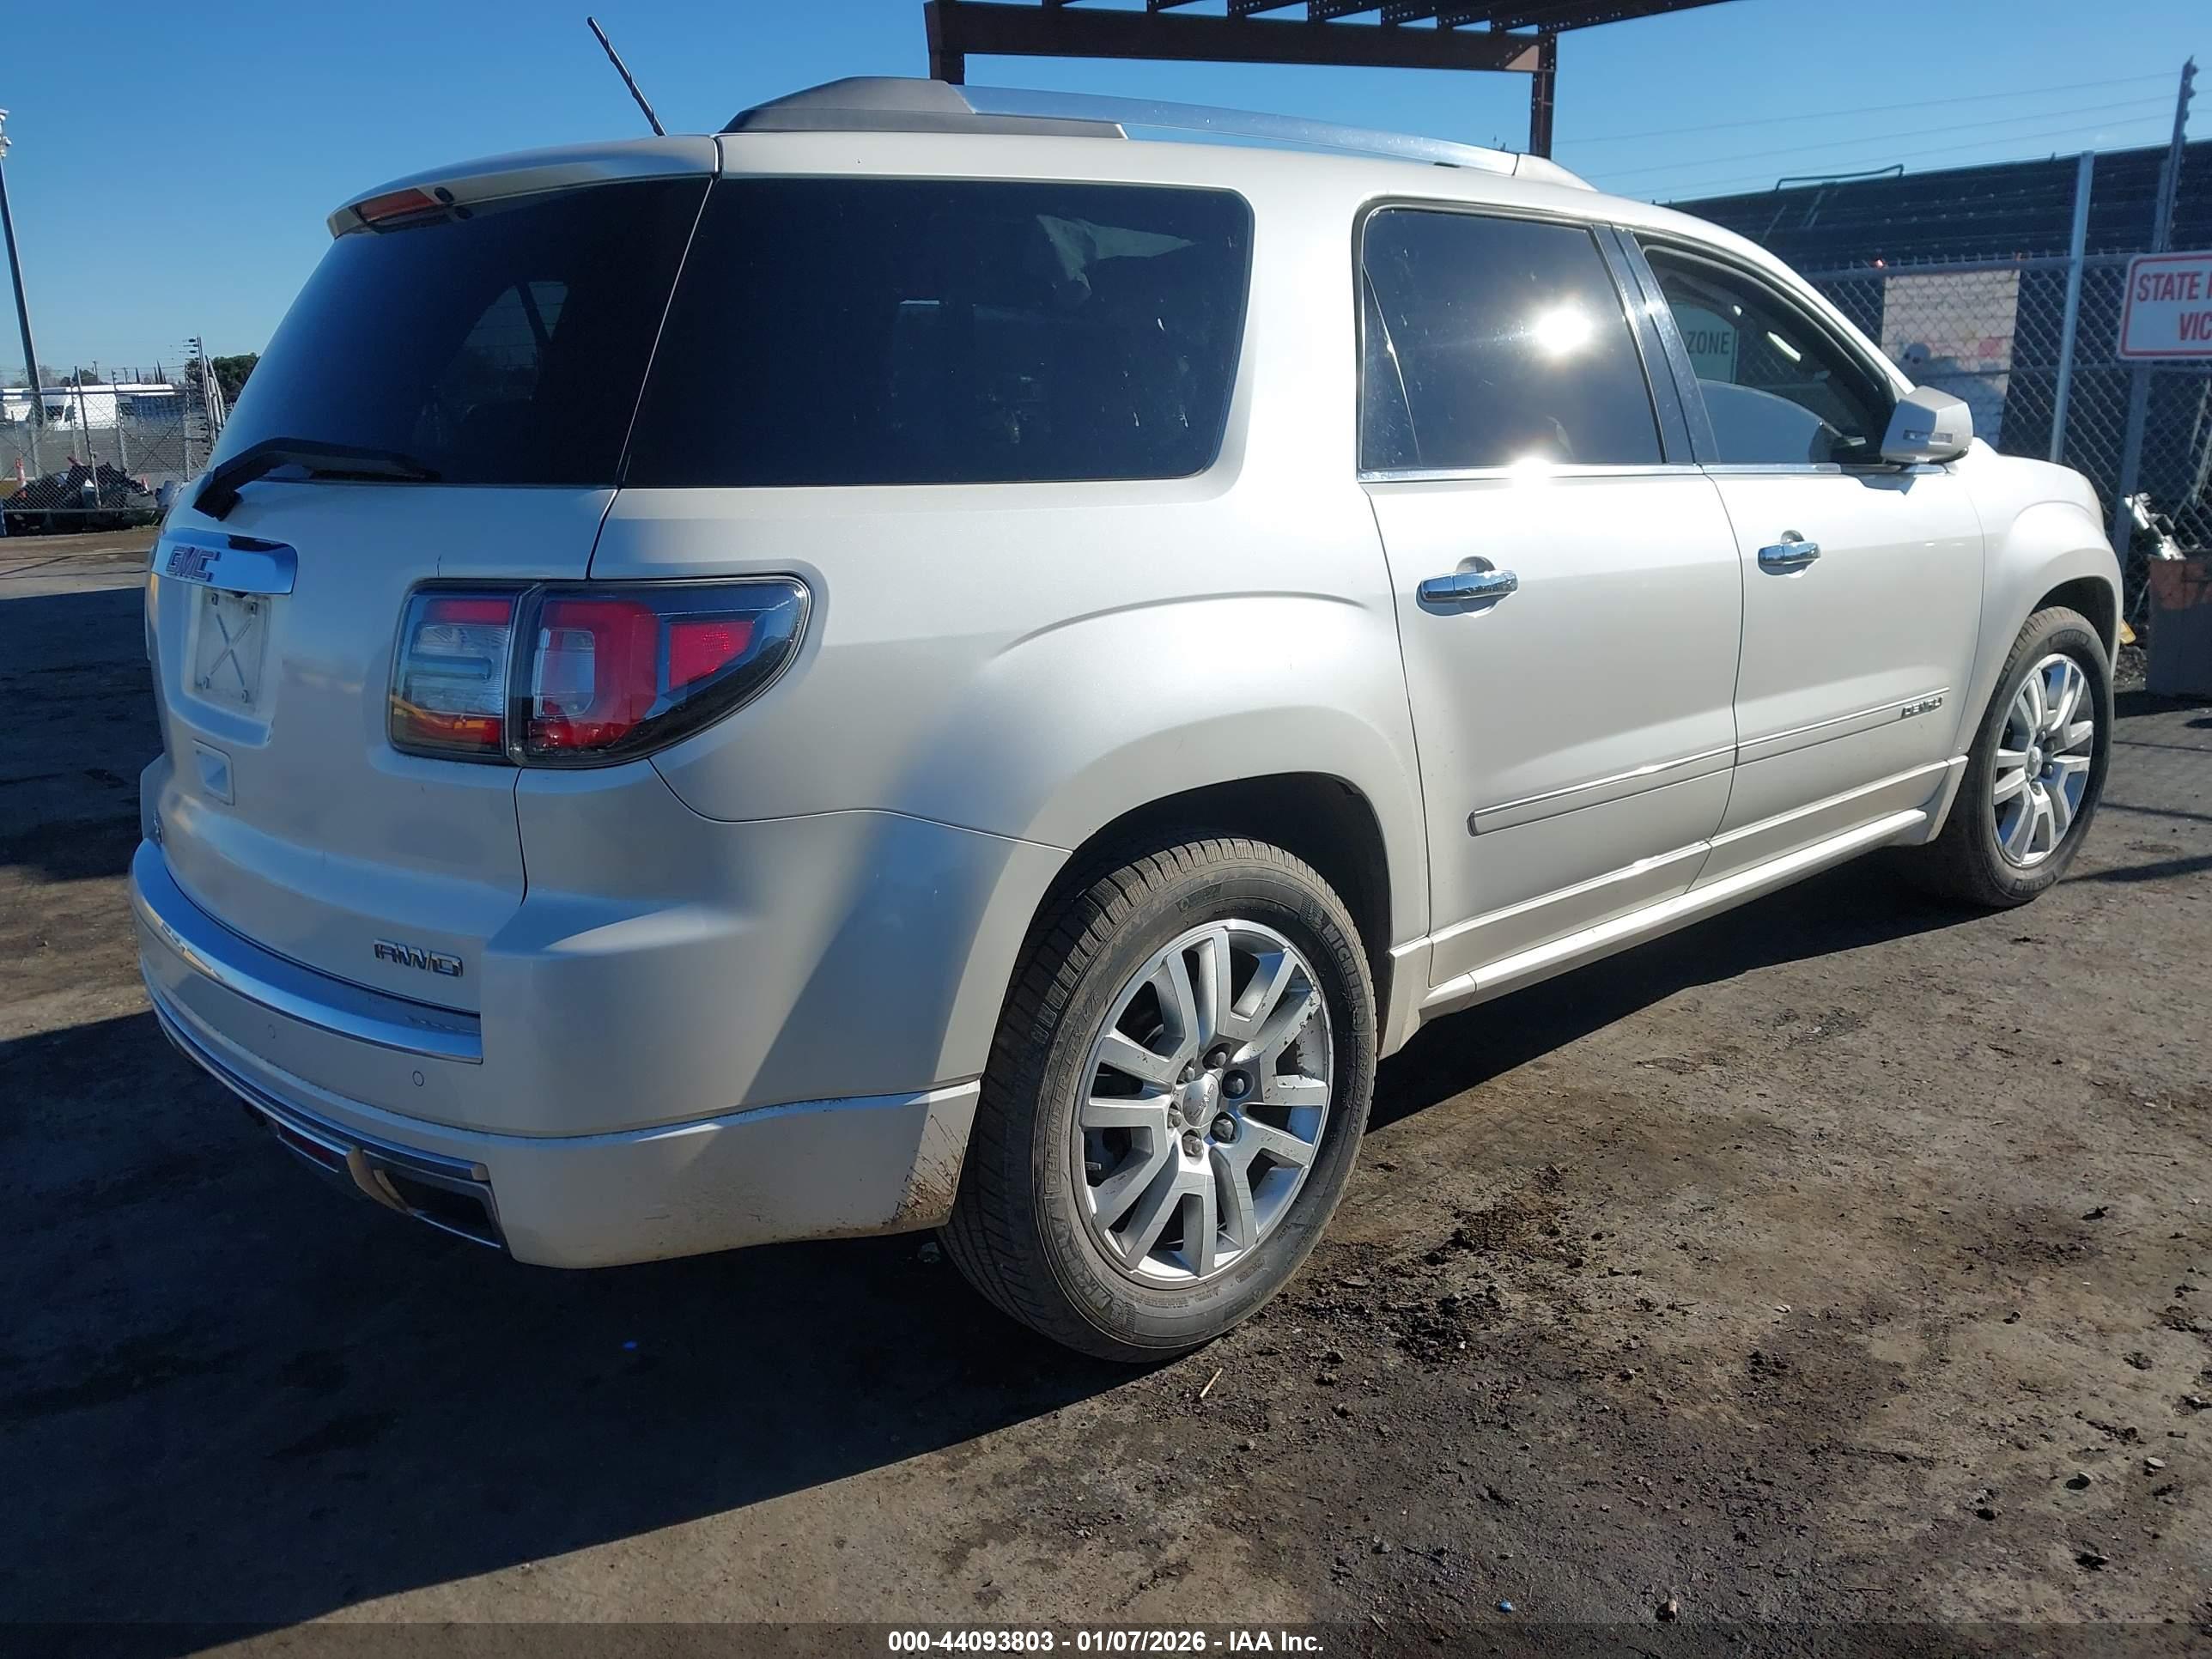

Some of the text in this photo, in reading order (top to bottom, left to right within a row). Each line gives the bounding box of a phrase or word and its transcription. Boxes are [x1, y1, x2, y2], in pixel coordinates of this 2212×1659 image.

[2136, 271, 2203, 302] STATE
[1686, 330, 1730, 355] ZONE
[166, 545, 221, 582] GMC
[373, 939, 464, 977] AWD
[1322, 923, 1369, 1030] MICHELIN
